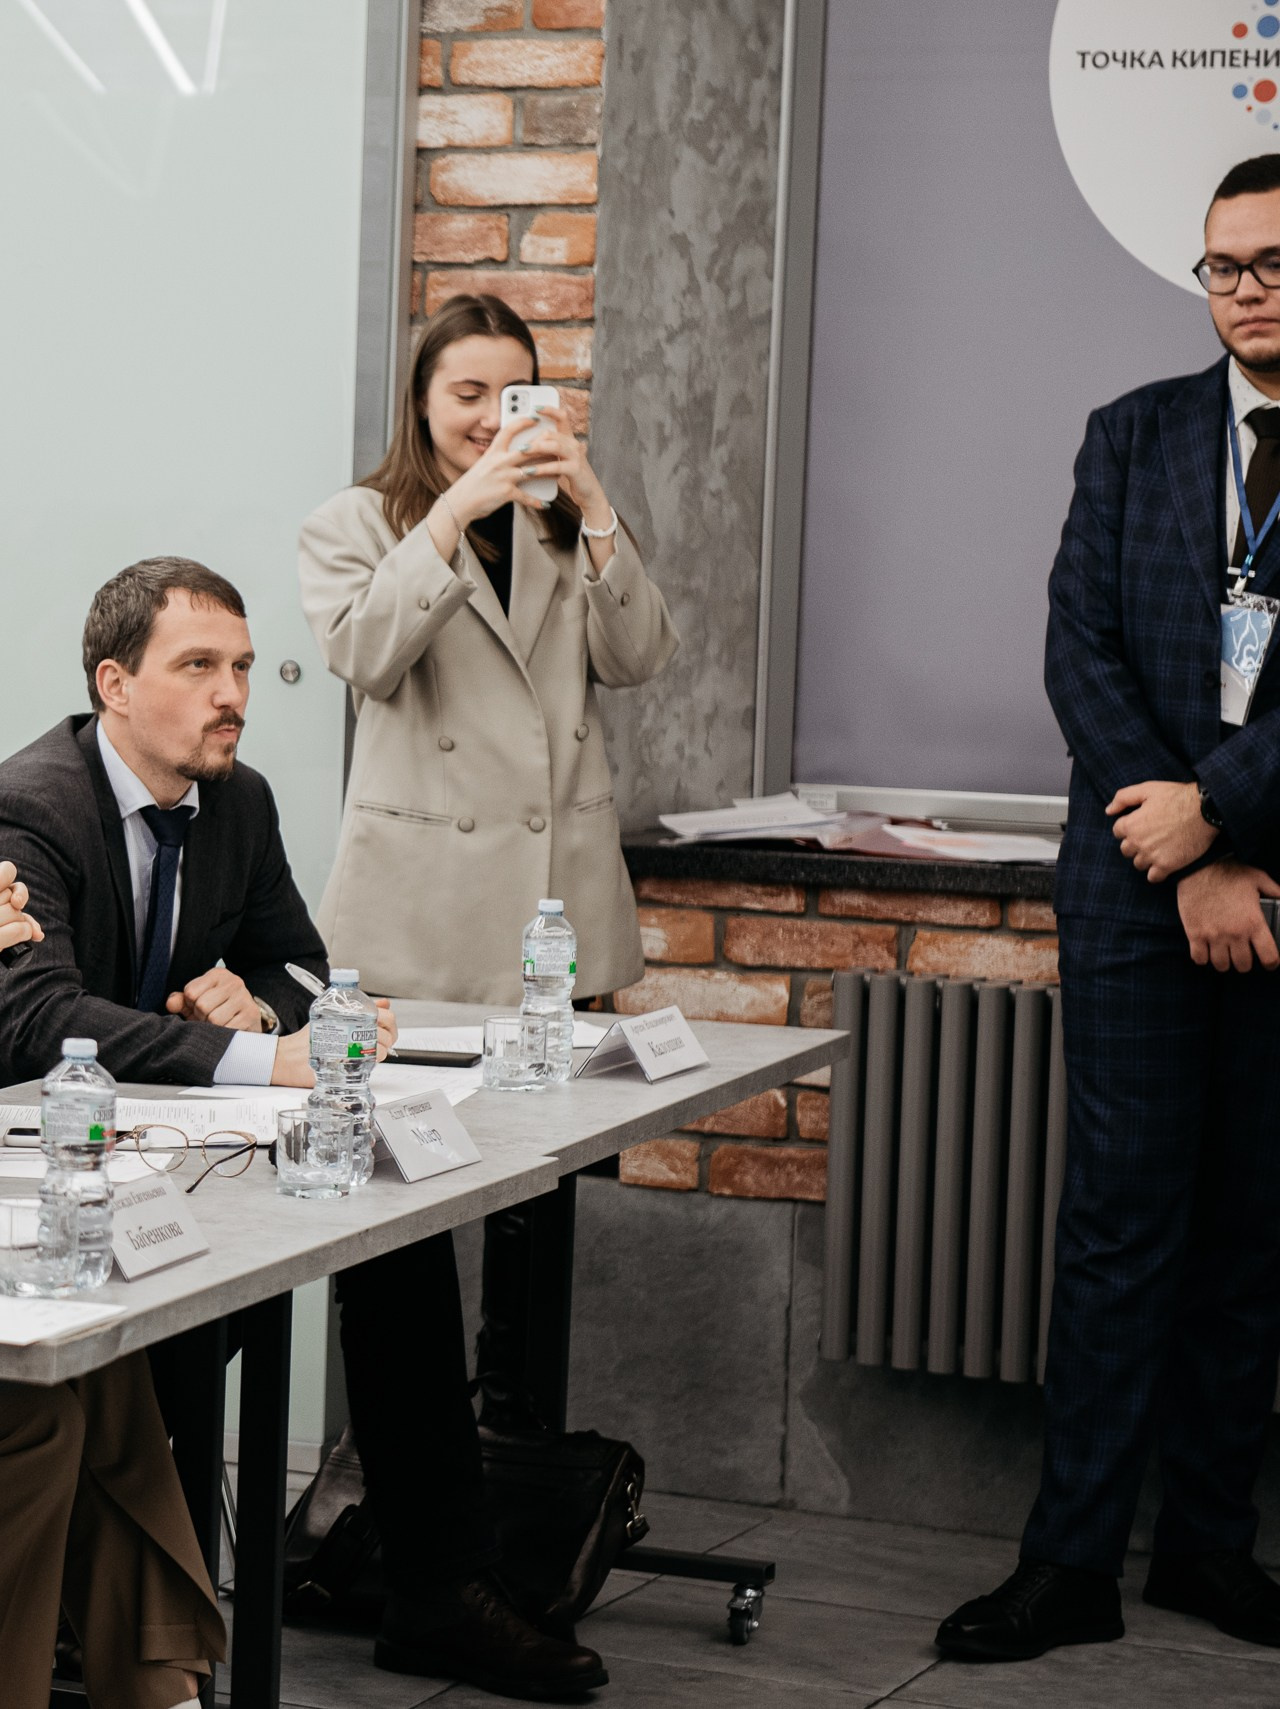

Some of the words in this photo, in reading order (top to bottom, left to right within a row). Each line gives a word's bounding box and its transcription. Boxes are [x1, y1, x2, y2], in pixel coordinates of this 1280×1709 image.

[1076, 50, 1165, 69] ТОЧКА
[1171, 49, 1280, 68] КИПЕНИ
[411, 1128, 444, 1146] Маер
[125, 1221, 184, 1251] Бабенкова
